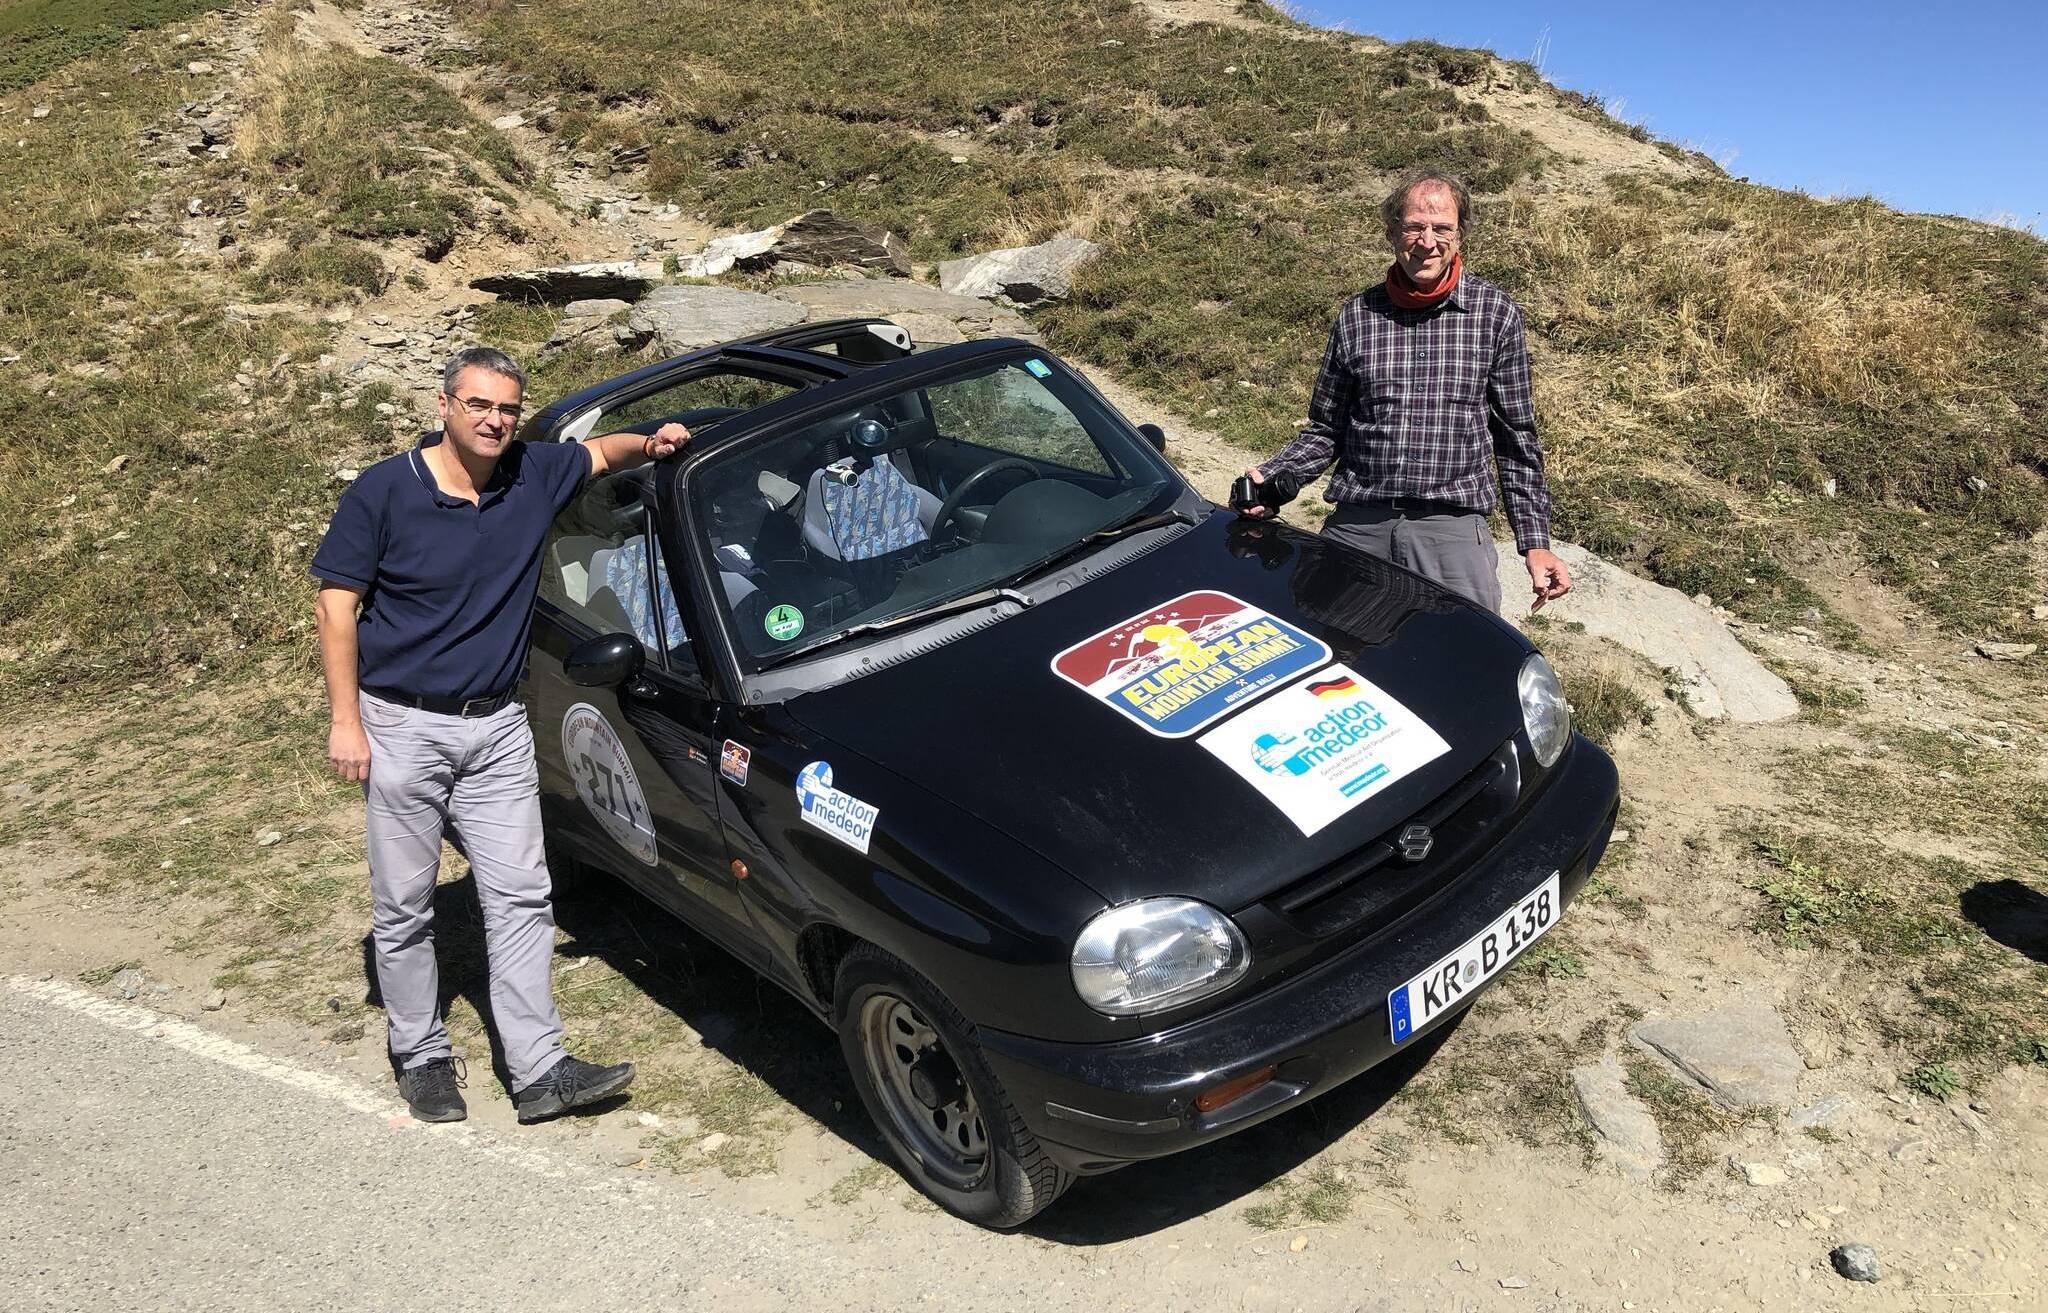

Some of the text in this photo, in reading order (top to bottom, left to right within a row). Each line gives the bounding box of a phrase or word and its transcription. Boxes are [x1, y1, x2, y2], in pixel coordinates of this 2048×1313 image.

[778, 607, 790, 622] 4
[1121, 620, 1283, 707] EUROPEAN
[1140, 633, 1302, 721] MOUNTAIN SUMMIT
[1301, 712, 1388, 768] medeor
[1303, 700, 1376, 743] action
[612, 743, 634, 785] SUMMIT
[580, 752, 637, 830] 271
[828, 792, 875, 825] action
[815, 802, 869, 841] medeor
[1422, 889, 1551, 1018] KR B 138
[1398, 1018, 1406, 1031] D
